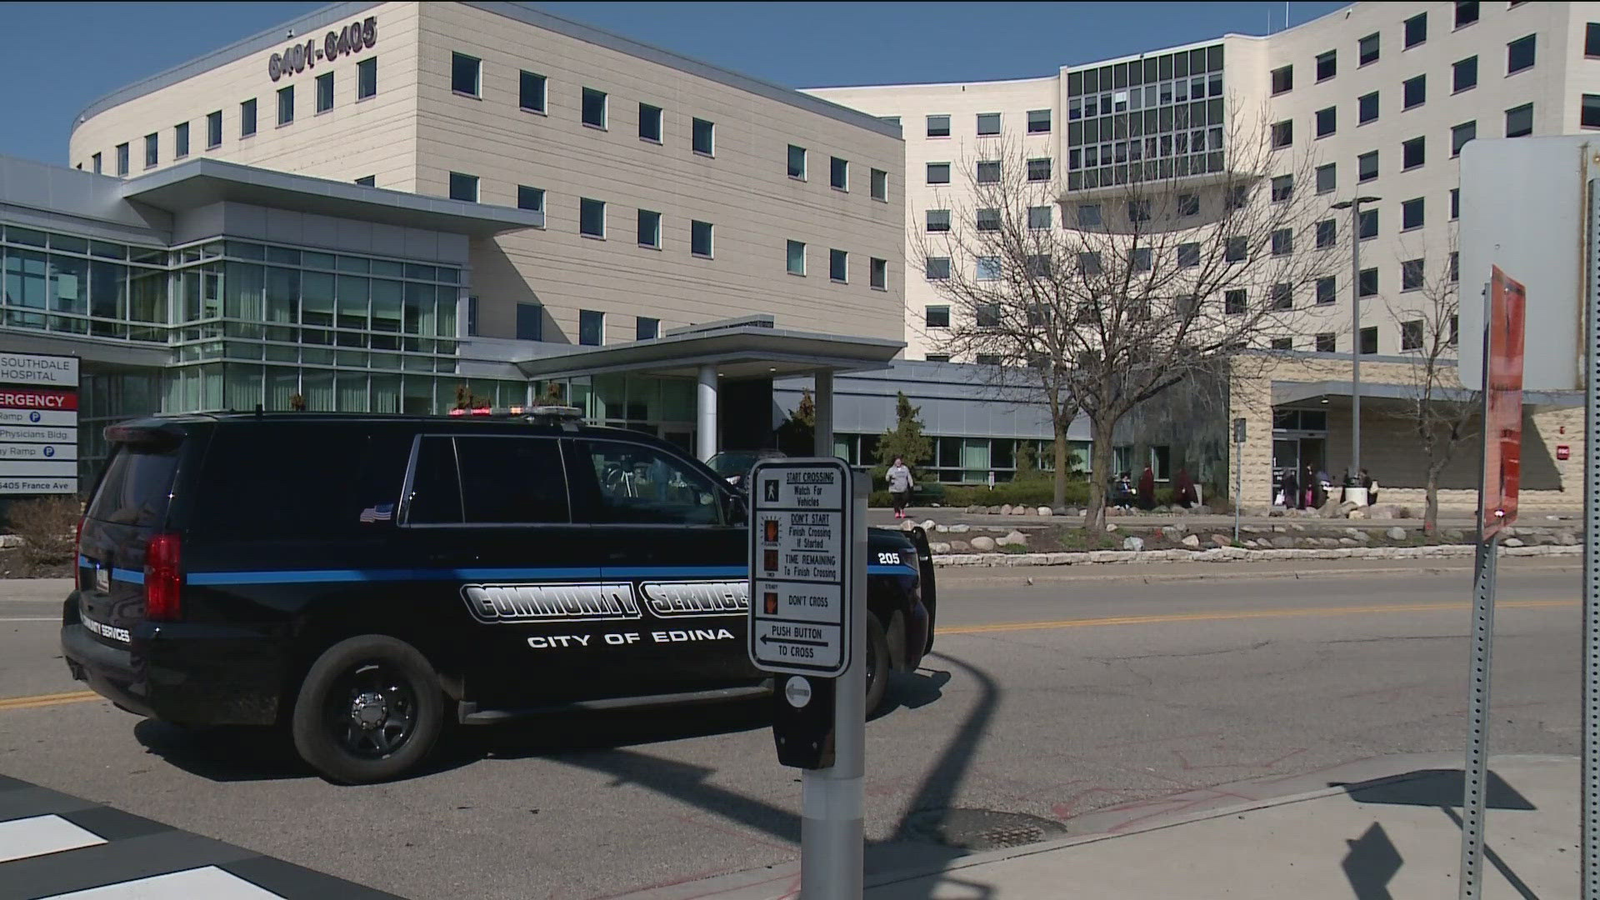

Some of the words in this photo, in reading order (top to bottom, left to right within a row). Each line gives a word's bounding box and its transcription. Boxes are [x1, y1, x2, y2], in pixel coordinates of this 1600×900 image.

[269, 16, 378, 82] 6401-6405
[1, 357, 70, 371] SOUTHDALE
[1, 369, 57, 382] HOSPITAL
[0, 429, 45, 439] Physicians
[10, 447, 36, 456] Ramp
[786, 472, 802, 482] START
[803, 472, 834, 482] CROSSING
[22, 482, 51, 490] France
[794, 486, 811, 495] Watch
[814, 486, 822, 496] For
[797, 497, 820, 507] Vehicles
[791, 514, 808, 524] DON'T
[811, 514, 829, 524] START
[789, 527, 806, 536] Finish
[808, 527, 831, 540] Crossing
[804, 539, 824, 548] Started
[786, 554, 799, 564] TIME
[802, 554, 836, 566] REMAINING
[878, 553, 900, 564] 205
[784, 566, 791, 576] To
[794, 566, 810, 577] Finish
[813, 567, 836, 581] Crossing
[464, 583, 640, 620] COMMUNITY
[788, 595, 807, 606] DON'T
[809, 597, 829, 607] CROSS
[101, 624, 131, 642] SERVICES
[771, 625, 792, 637] PUSH
[794, 627, 822, 639] BUTTON
[527, 635, 590, 649] CITY
[604, 632, 641, 645] OF
[651, 628, 735, 643] EDINA
[778, 645, 788, 656] TO
[790, 646, 814, 658] CROSS
